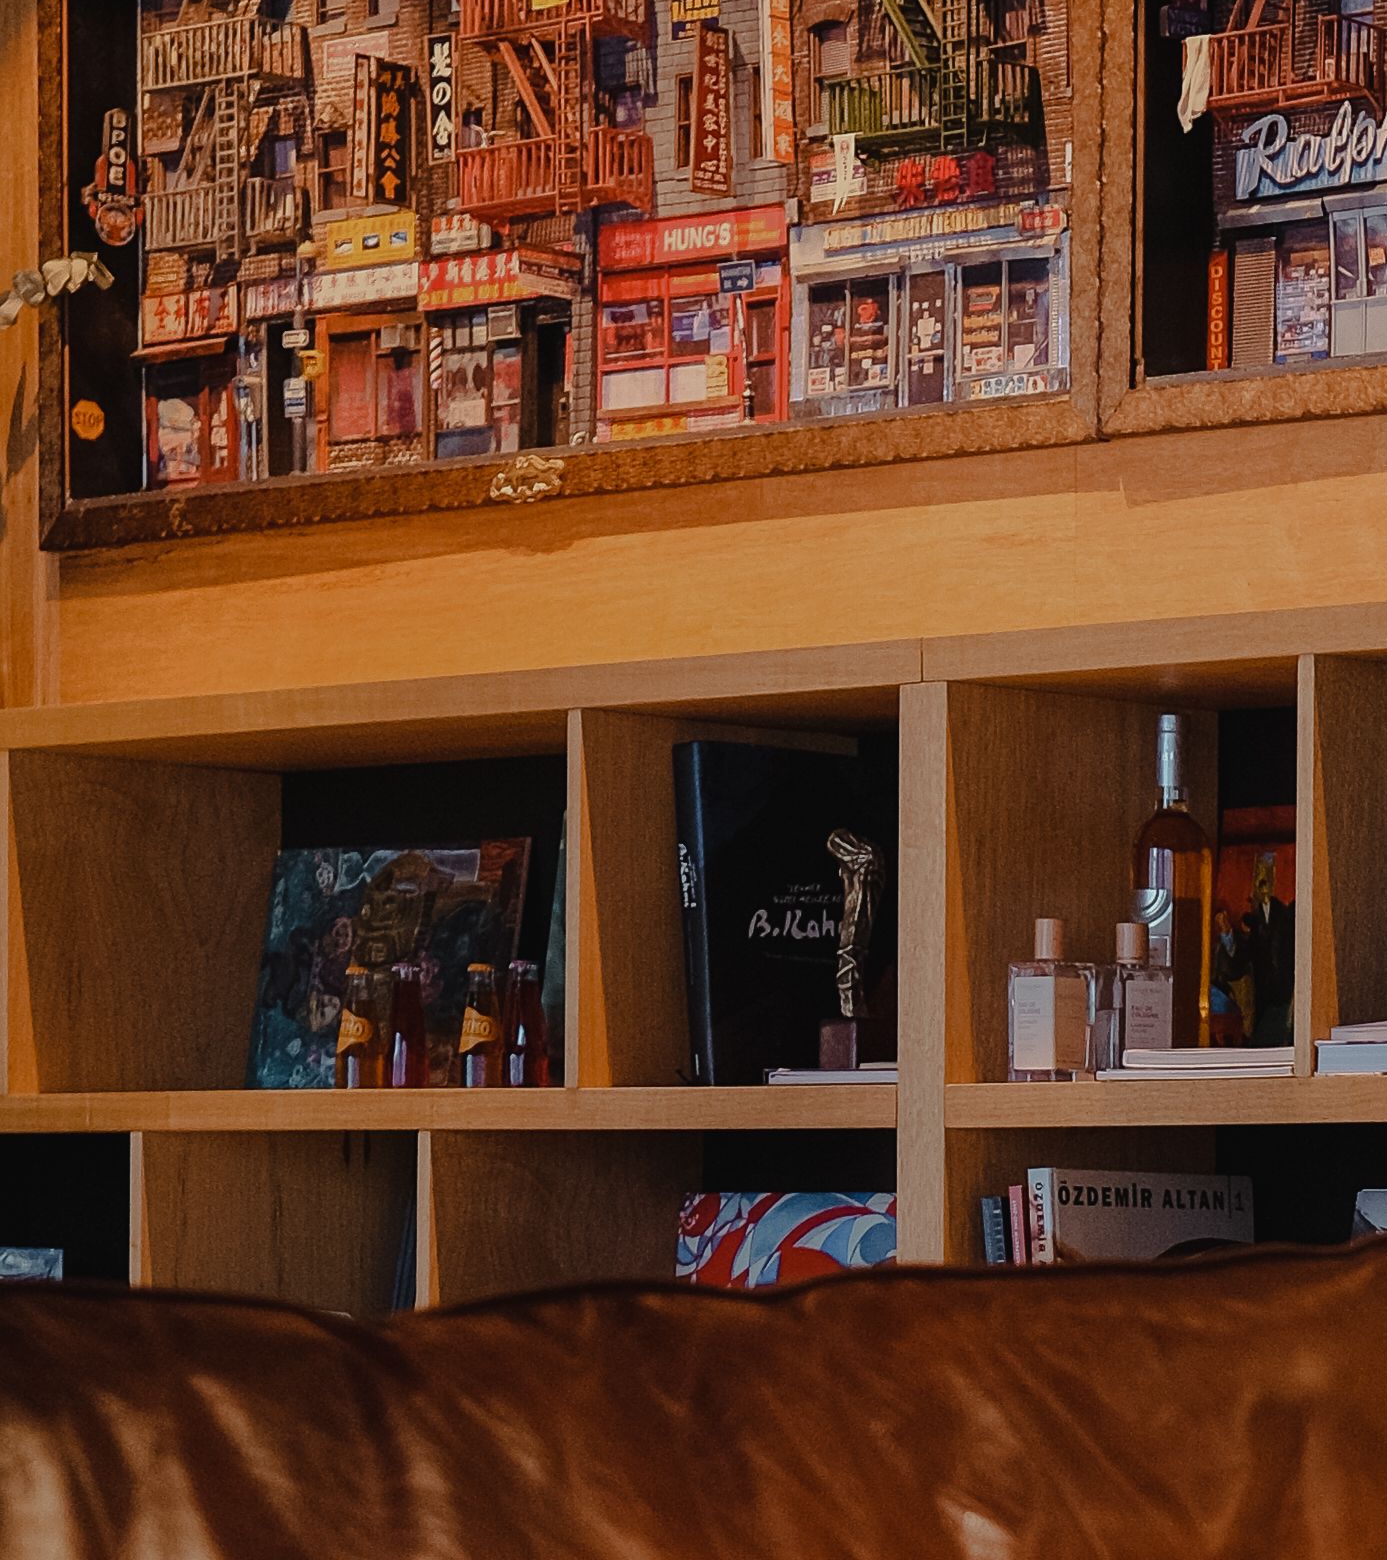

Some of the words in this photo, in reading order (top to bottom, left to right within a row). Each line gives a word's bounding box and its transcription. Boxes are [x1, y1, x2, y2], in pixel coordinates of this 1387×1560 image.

[663, 221, 732, 252] HUNG'S
[1210, 266, 1224, 371] DISCOUNT
[748, 908, 843, 940] B.Rah
[1057, 1178, 1153, 1210] ÖZDEMİR
[1162, 1184, 1226, 1211] ALTAN
